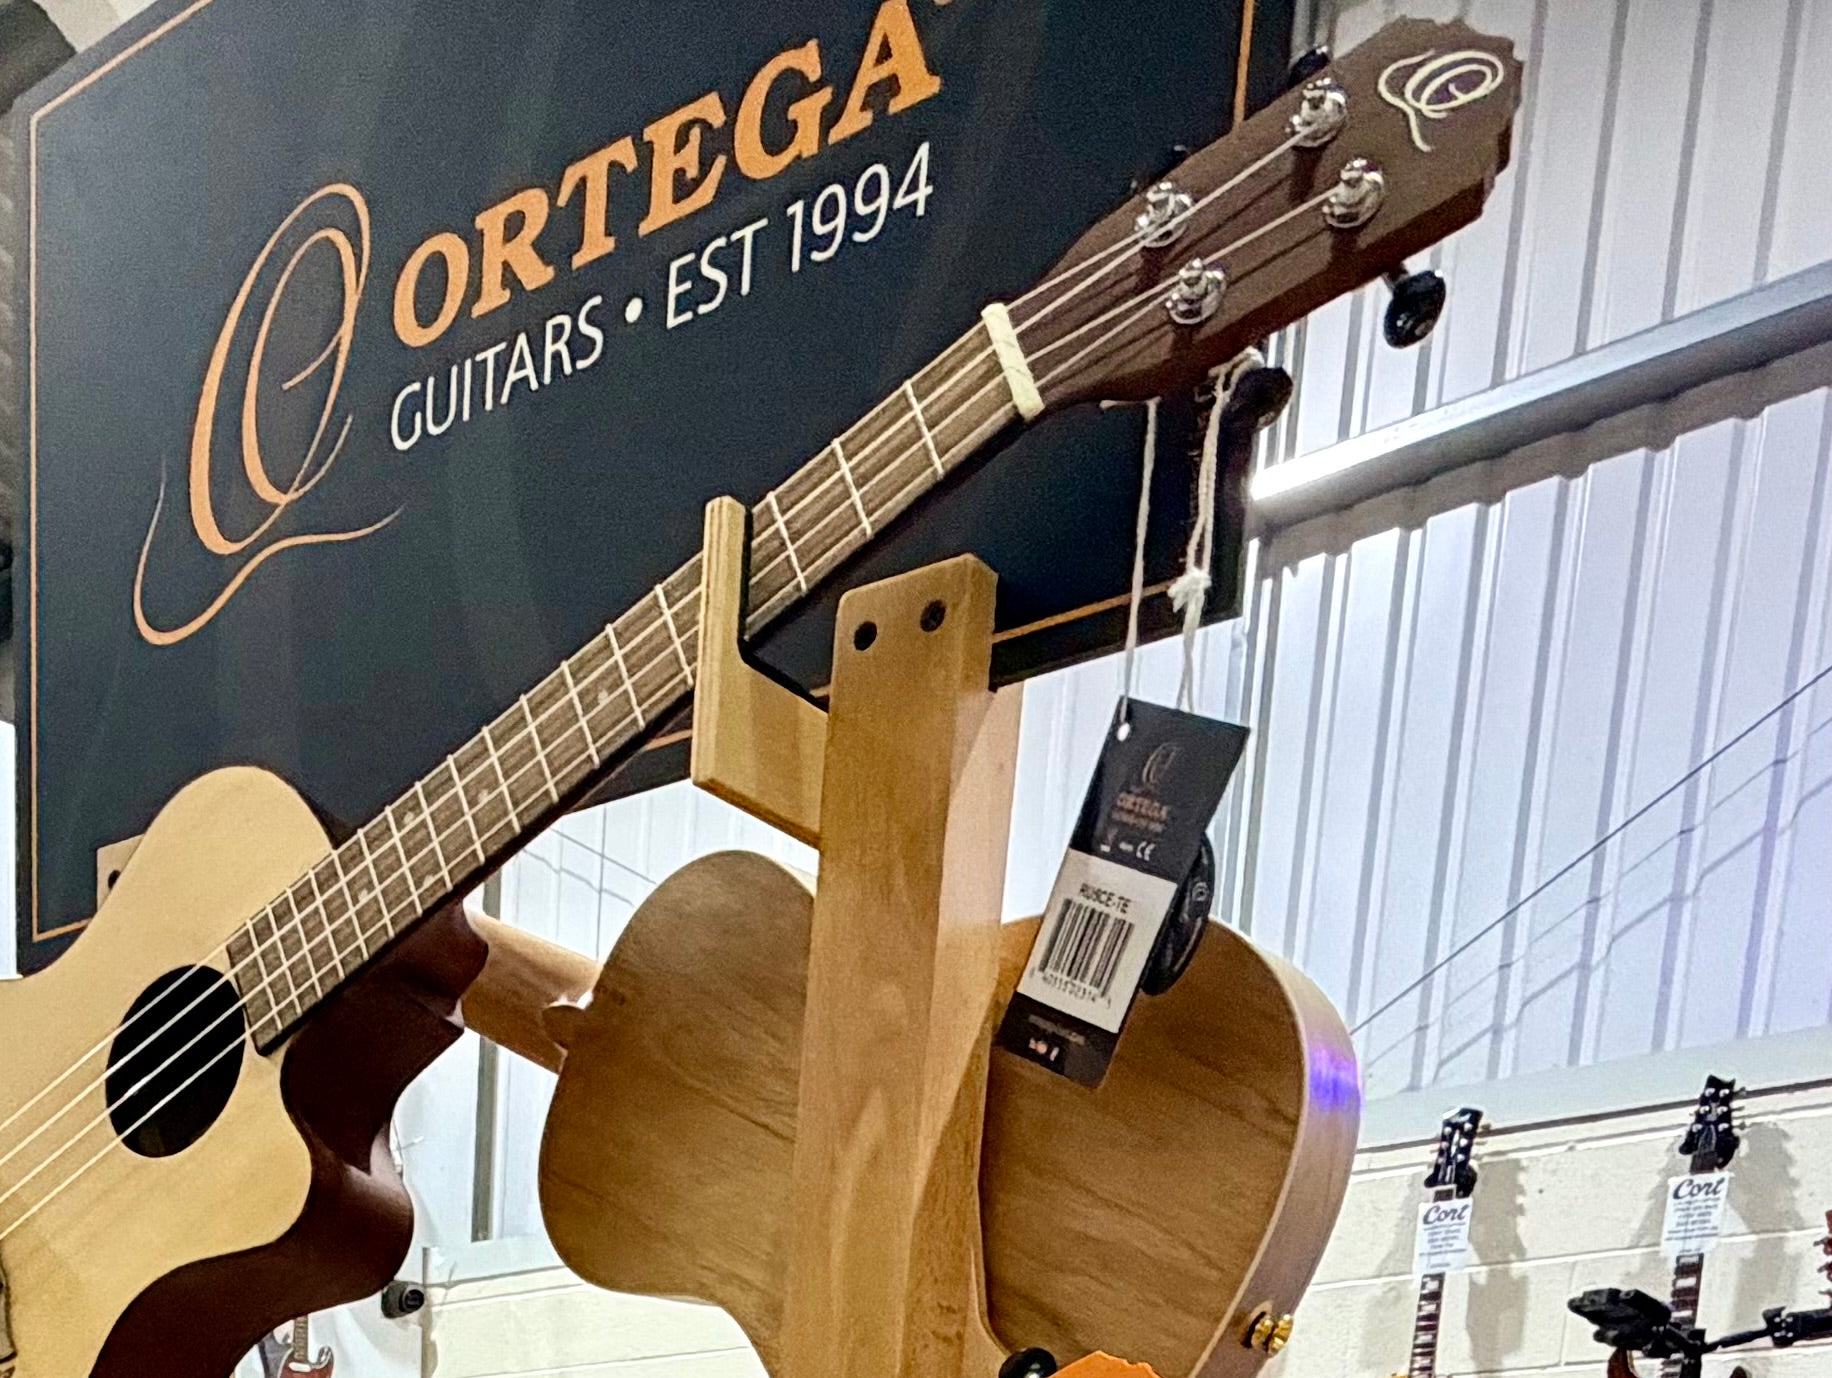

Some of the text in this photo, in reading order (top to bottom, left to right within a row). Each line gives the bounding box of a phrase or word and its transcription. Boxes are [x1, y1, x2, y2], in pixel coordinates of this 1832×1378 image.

[393, 0, 941, 348] ORTEGA
[390, 142, 935, 452] GUITARS EST 1994
[1422, 1204, 1470, 1226] Cort
[1672, 1177, 1725, 1200] Cort
